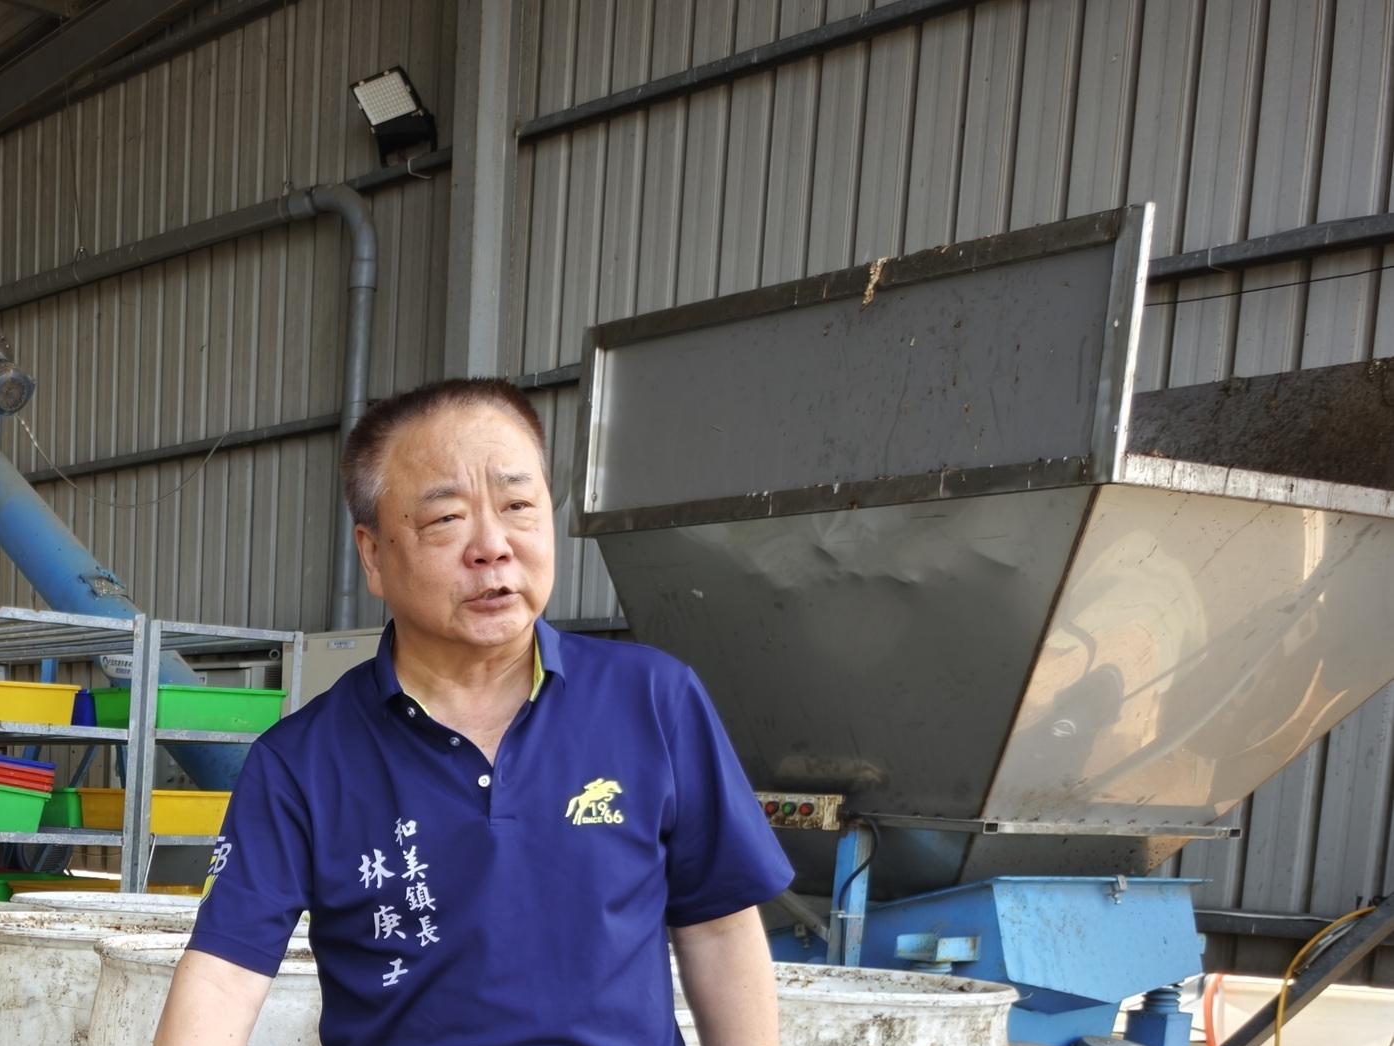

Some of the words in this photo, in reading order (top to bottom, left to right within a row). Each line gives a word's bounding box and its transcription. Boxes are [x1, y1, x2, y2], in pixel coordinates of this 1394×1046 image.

[358, 849, 409, 987] 林庚壬
[394, 817, 441, 948] 和美鎮長
